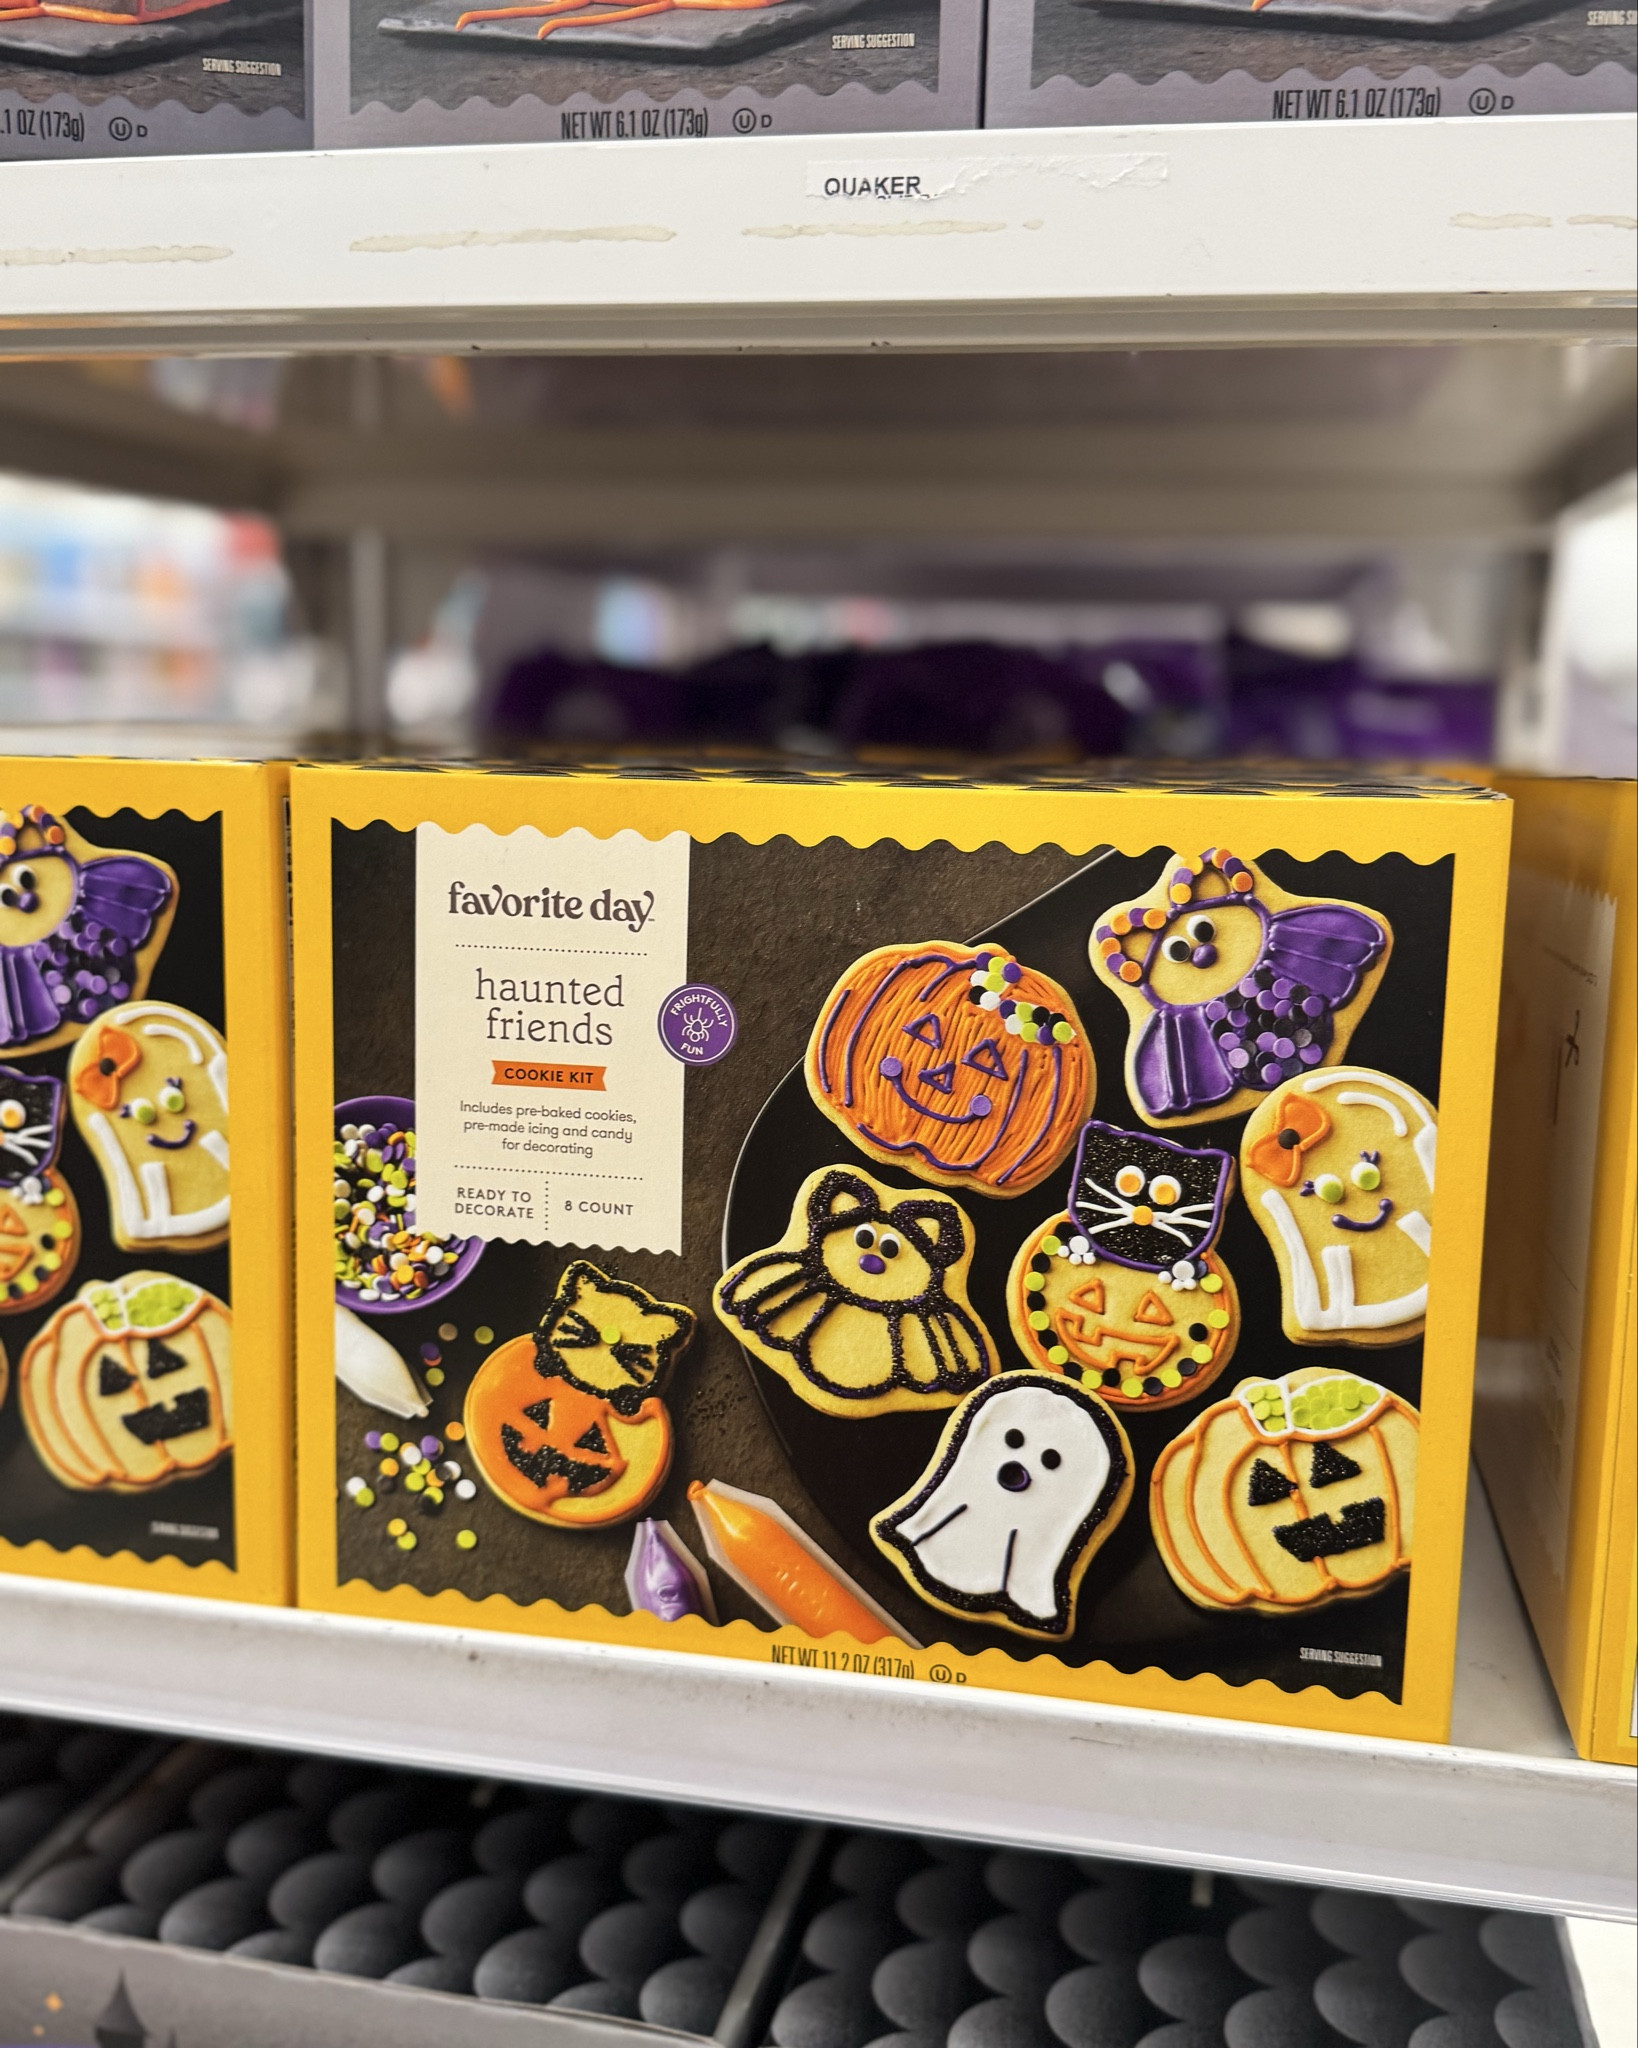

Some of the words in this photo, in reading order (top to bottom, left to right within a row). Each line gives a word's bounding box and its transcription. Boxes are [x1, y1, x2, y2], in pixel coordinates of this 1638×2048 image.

[832, 34, 865, 50] SERVING
[866, 33, 915, 49] SUGGESTION
[1272, 89, 1304, 120] NET
[1306, 89, 1332, 119] WT
[1335, 88, 1358, 119] 6.1
[1364, 88, 1387, 118] OZ
[1389, 86, 1441, 118] (173g)
[17, 109, 36, 136] OZ
[40, 110, 85, 143] (173g)
[561, 111, 587, 140] NET
[590, 111, 612, 138] WT
[616, 110, 636, 138] 6.1
[642, 109, 660, 137] OZ
[664, 107, 709, 138] (173g)
[824, 176, 921, 196] QUAKER
[448, 880, 584, 920] favorite
[590, 887, 655, 933] day
[475, 967, 625, 1007] haunted
[670, 993, 728, 1027] FRIGHTFULLY
[486, 1006, 613, 1046] friends
[680, 1042, 704, 1056] FUN
[504, 1067, 564, 1083] COOKIE
[569, 1071, 595, 1084] KIT
[460, 1100, 513, 1115] Includes
[516, 1105, 581, 1119] pre-baked
[584, 1109, 637, 1125] cookies,
[463, 1120, 525, 1133] pre-made
[528, 1122, 559, 1138] icing
[562, 1125, 588, 1137] and
[591, 1128, 633, 1143] candy
[502, 1138, 520, 1151] for
[523, 1139, 593, 1158] decorating
[457, 1187, 506, 1201] READY
[511, 1190, 532, 1203] TO
[455, 1202, 534, 1219] DECORATE
[564, 1200, 573, 1212] 8
[578, 1201, 634, 1216] COUNT
[798, 1647, 819, 1668] WT
[823, 1650, 850, 1671] 112
